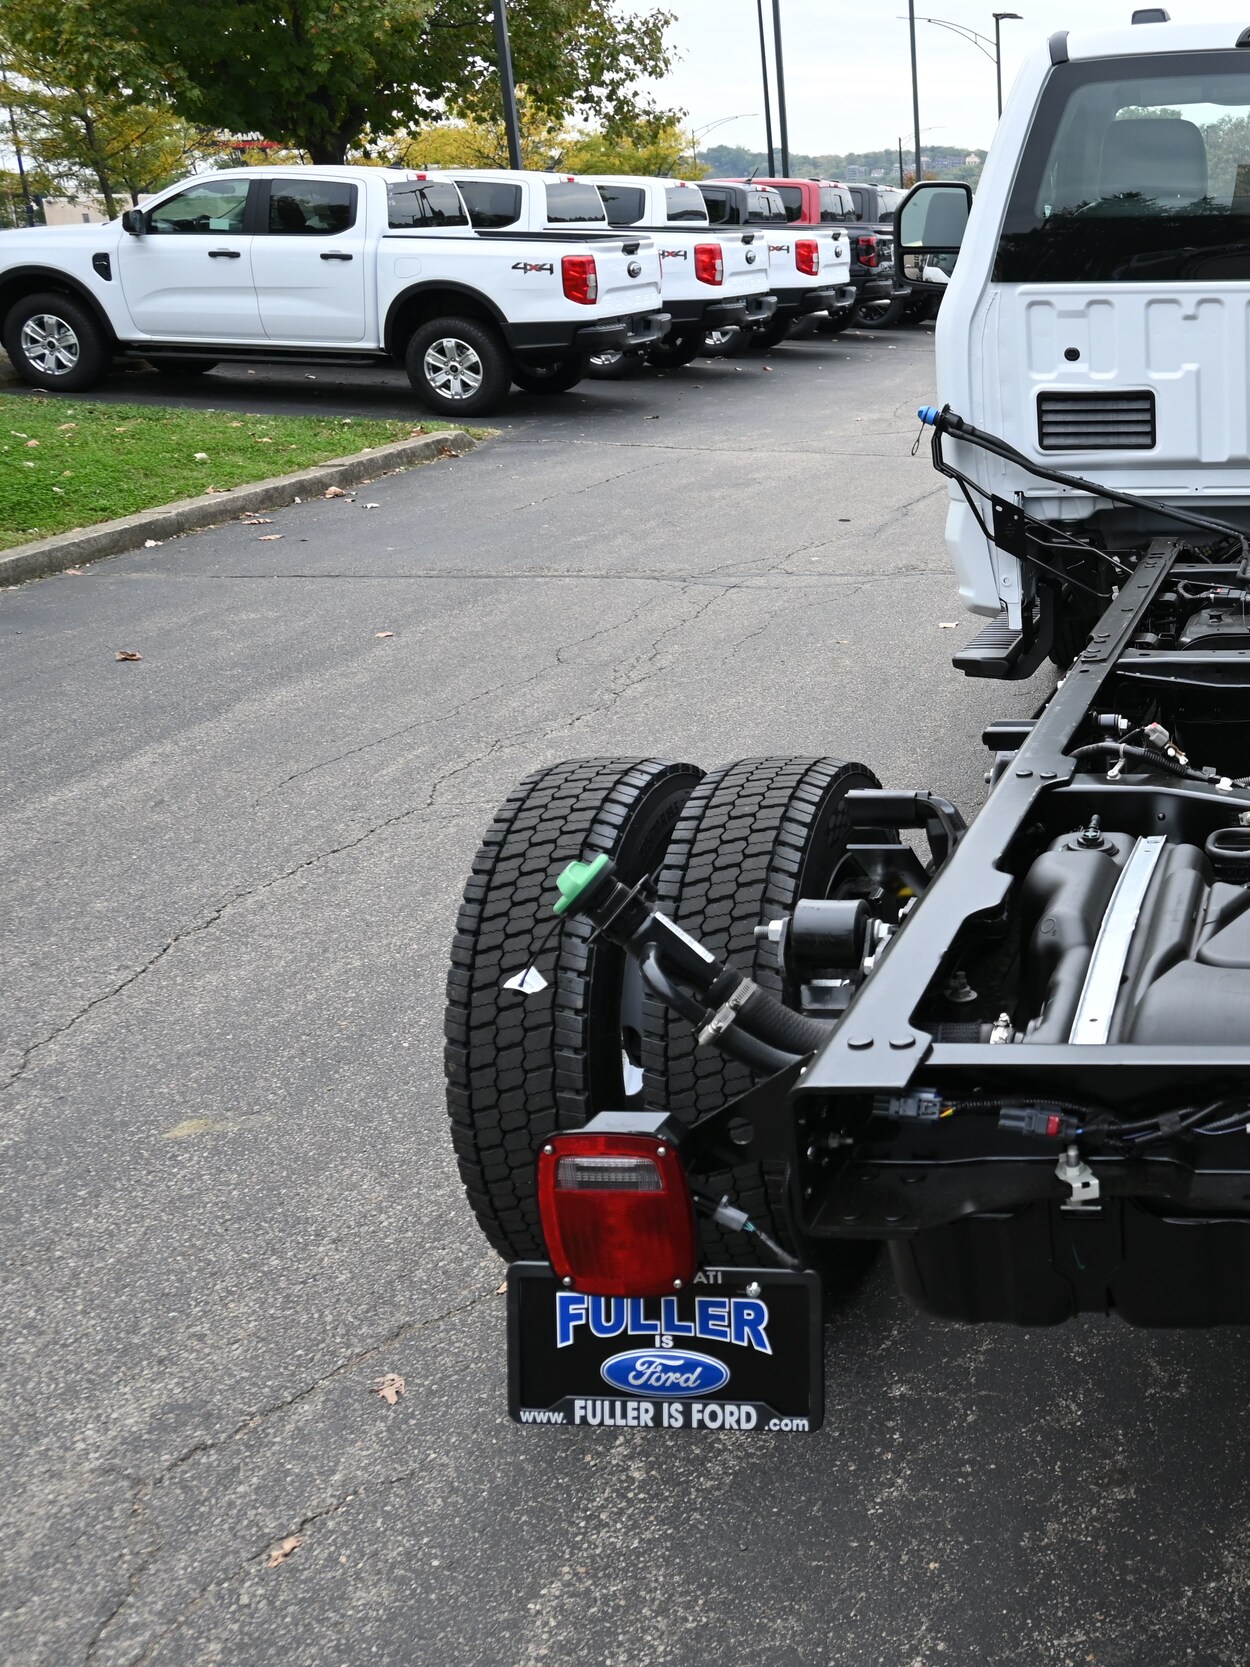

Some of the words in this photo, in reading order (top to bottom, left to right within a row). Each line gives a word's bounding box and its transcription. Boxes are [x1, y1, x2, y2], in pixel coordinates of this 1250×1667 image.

[769, 244, 789, 254] x4
[511, 262, 554, 275] 4x4
[692, 1271, 723, 1284] ATI
[556, 1292, 773, 1355] FULLER
[654, 1334, 674, 1349] IS
[627, 1356, 703, 1389] Ford
[519, 1410, 567, 1424] www.
[574, 1399, 655, 1427] FULLER
[662, 1402, 684, 1428] IS
[691, 1403, 758, 1430] FORD
[764, 1418, 809, 1432] .com
